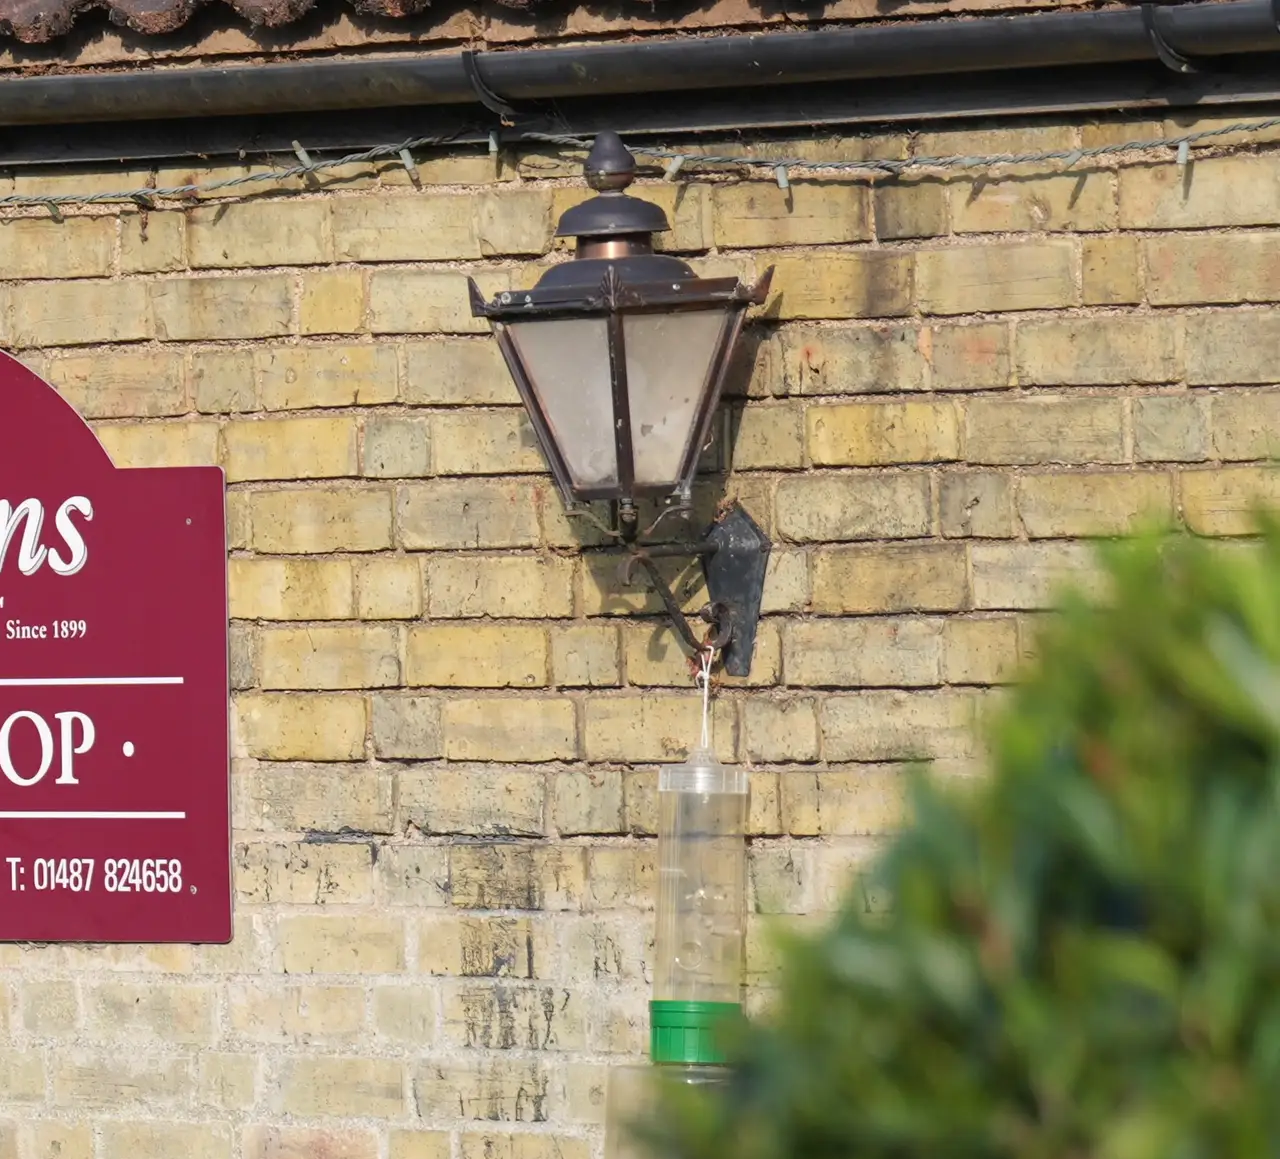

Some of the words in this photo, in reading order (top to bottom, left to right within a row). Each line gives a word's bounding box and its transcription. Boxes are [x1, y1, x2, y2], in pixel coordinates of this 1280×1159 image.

[6, 619, 47, 640] Since
[52, 619, 87, 640] 1899
[5, 857, 26, 891] T:
[33, 857, 95, 892] 01487
[104, 858, 183, 893] 824658
